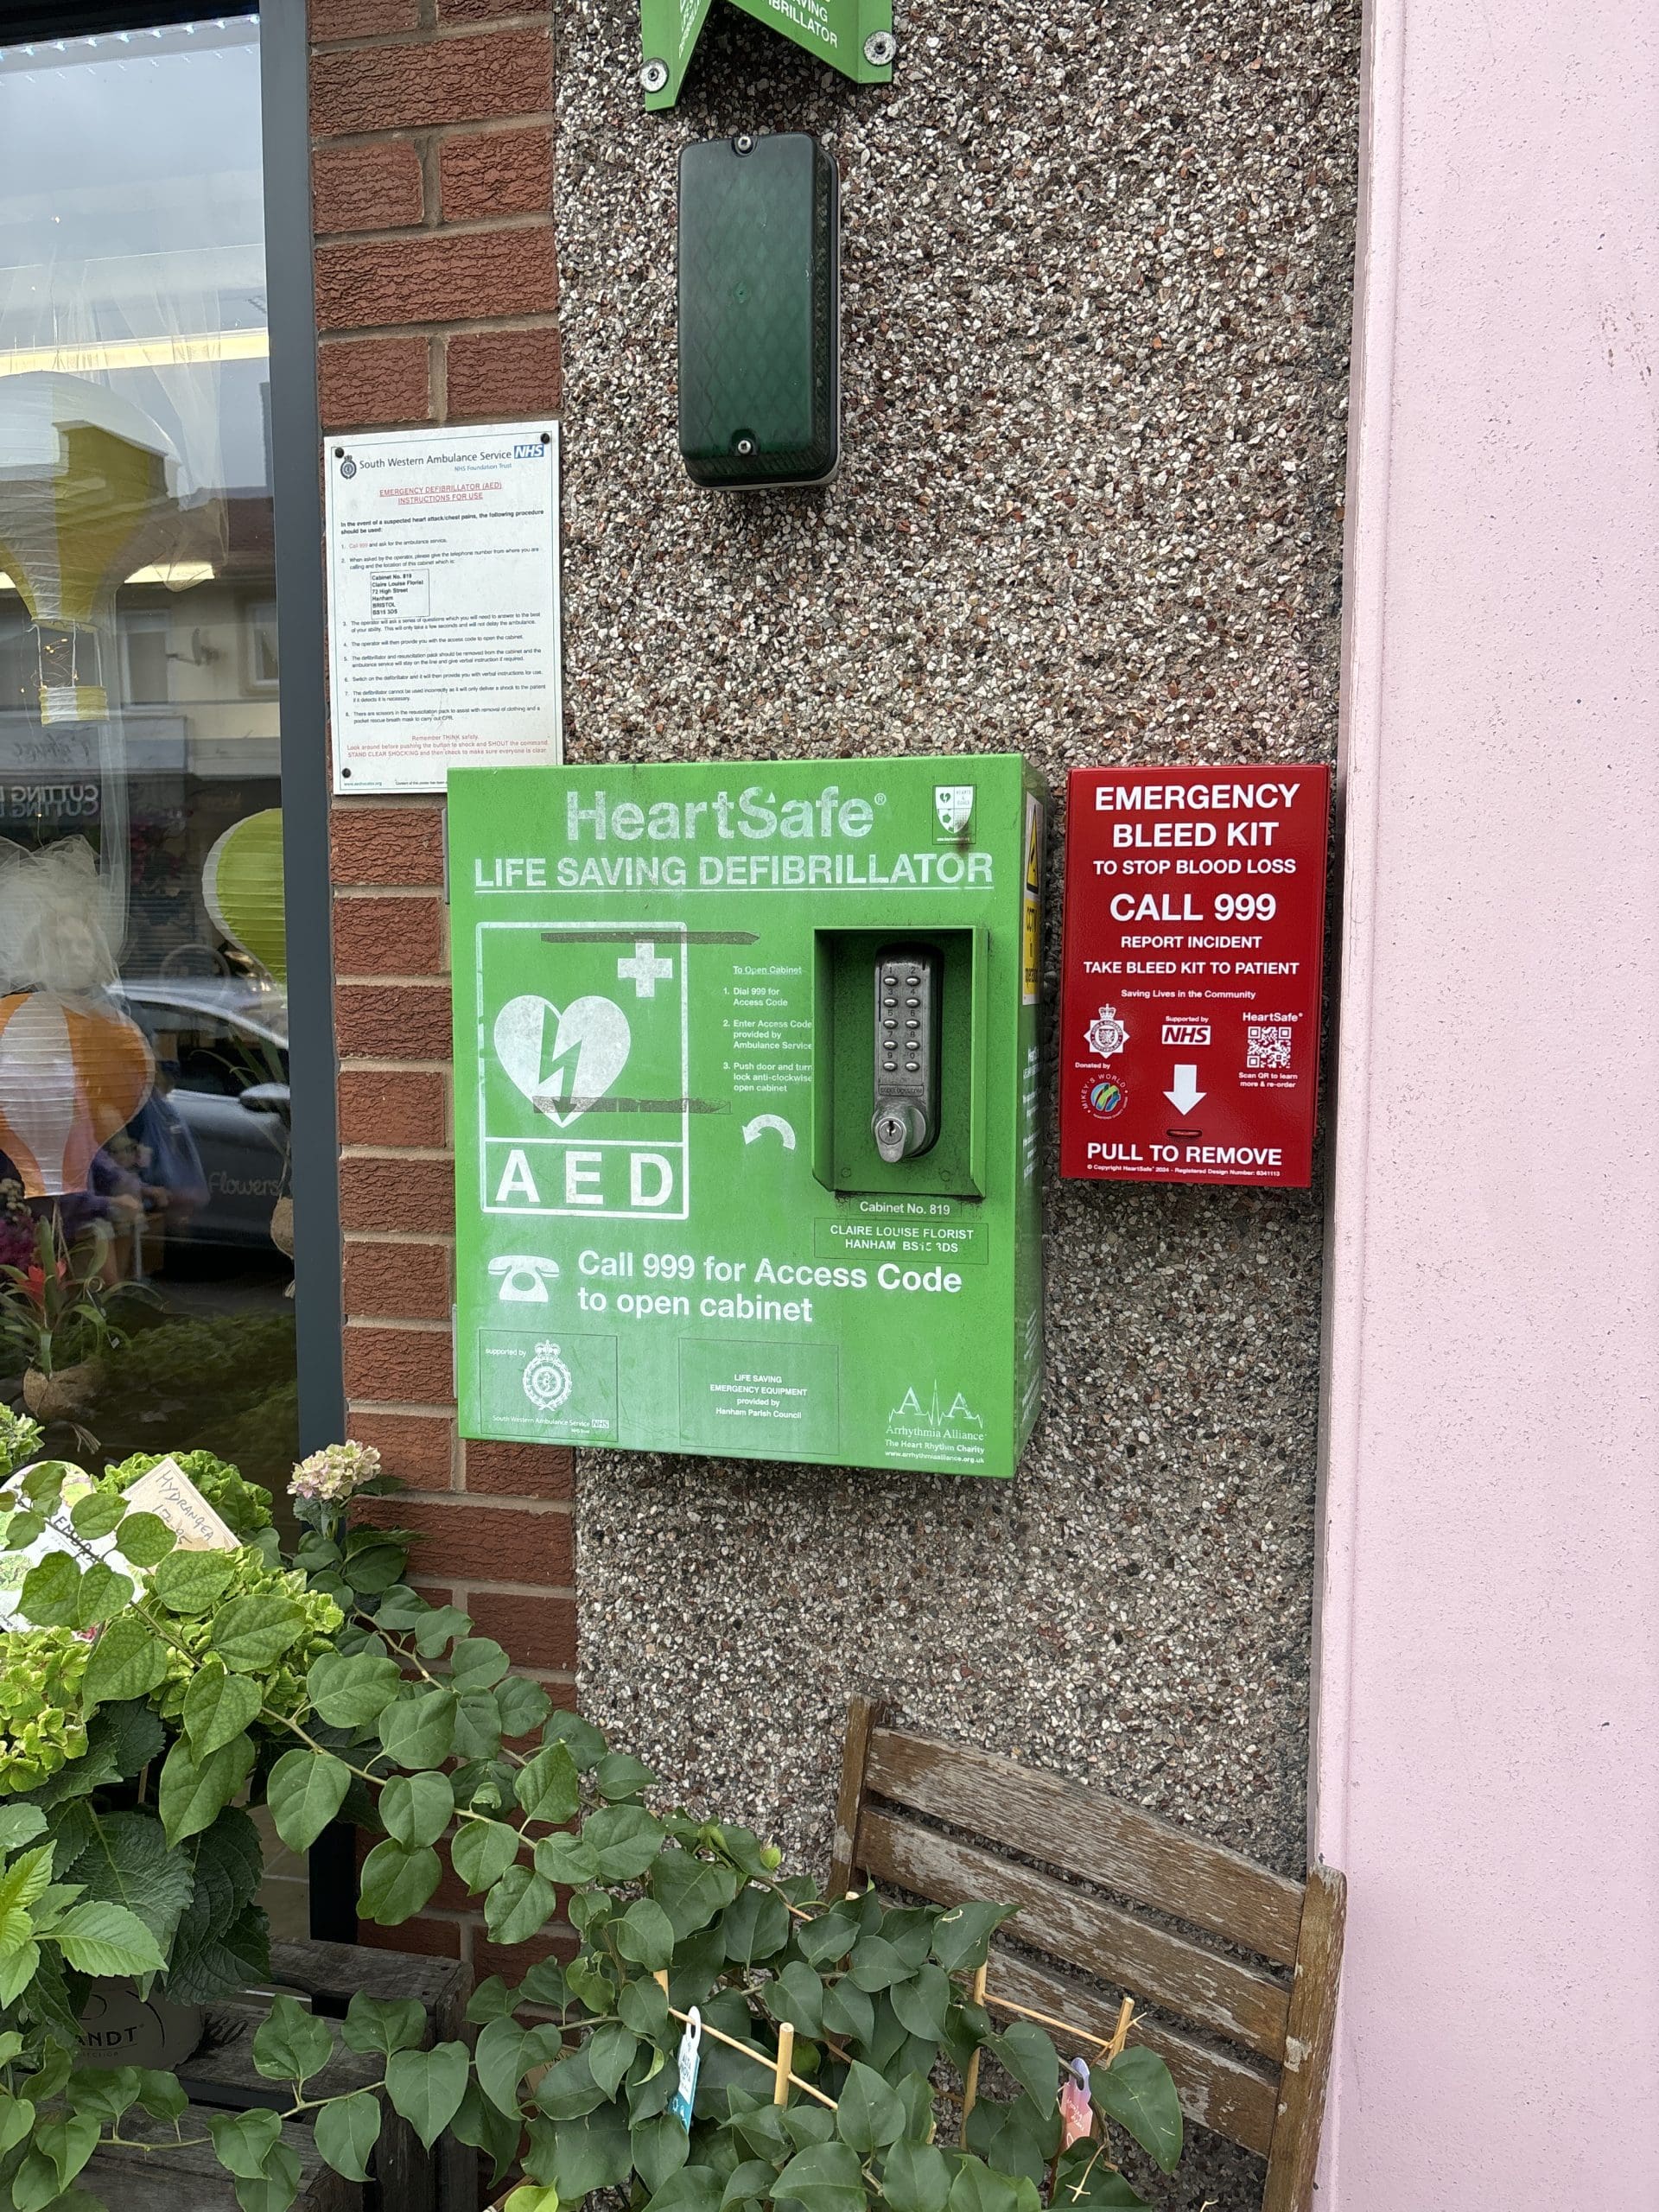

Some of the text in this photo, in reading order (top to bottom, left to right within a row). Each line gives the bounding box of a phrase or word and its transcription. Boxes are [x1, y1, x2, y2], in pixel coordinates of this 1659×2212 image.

[359, 444, 544, 469] South Western Ambulance Service NHS
[379, 481, 502, 497] EMERGENCY DEFIBRILLATOR (AED)
[397, 492, 484, 505] INSTRUCTIONS FOR USE
[1095, 784, 1300, 810] EMERGENCY
[1113, 822, 1280, 848] BLEED KIT
[474, 852, 994, 887] LIFE SAVING DEFIBRILLATOR
[1093, 859, 1297, 875] TO STOP BLOOD LOSS
[1109, 893, 1277, 922] CALL 999
[1121, 936, 1263, 949] REPORT INCIDENT
[733, 966, 803, 976] To Open Cabinet
[888, 966, 916, 975] 1 2
[1084, 961, 1300, 976] TAKE BLEED KIT TO PATIENT
[723, 987, 780, 995] 1. Dial 999 for
[1121, 989, 1151, 999] Saving
[1152, 989, 1176, 998] Lives
[1178, 989, 1186, 998] in
[1204, 990, 1256, 1000] Community
[733, 998, 789, 1007] Access Code
[722, 1019, 731, 1027] 2.
[757, 1020, 789, 1028] Access
[733, 1031, 782, 1039] provided by
[1163, 1026, 1210, 1044] NHS
[733, 1041, 812, 1051] Ambulance Service
[733, 1062, 754, 1071] Push
[778, 1063, 794, 1071] and
[733, 1073, 812, 1083] lock anti-clockwise
[1097, 1073, 1126, 1088] WORLD
[755, 1084, 788, 1093] cabinet
[1087, 1142, 1282, 1166] PULL TO REMOVE
[209, 1170, 278, 1197] Flowers
[860, 1201, 951, 1215] Cabinet No. 819
[830, 1224, 975, 1240] CLAIRE LOUISE FLORIST
[845, 1239, 897, 1250] HANHAM
[577, 1249, 963, 1294] Call 999 for Access Code
[578, 1287, 814, 1323] to open cabinet
[485, 1347, 527, 1358] supported by
[753, 1375, 783, 1383] SAVING
[709, 1384, 808, 1396] EMERGENCY EQUIPMENT
[770, 1399, 781, 1408] by
[715, 1408, 803, 1419] Hanham Parish Council
[535, 1417, 569, 1426] Ambulance
[592, 1419, 610, 1429] NHS
[886, 1426, 984, 1441] Arrhythmia Alliance
[885, 1439, 985, 1455] The Heart Rhythm Charity
[884, 1451, 985, 1464] www.arrhythmiaalliance.org.uk
[156, 1469, 214, 1541] HYDRANGEA
